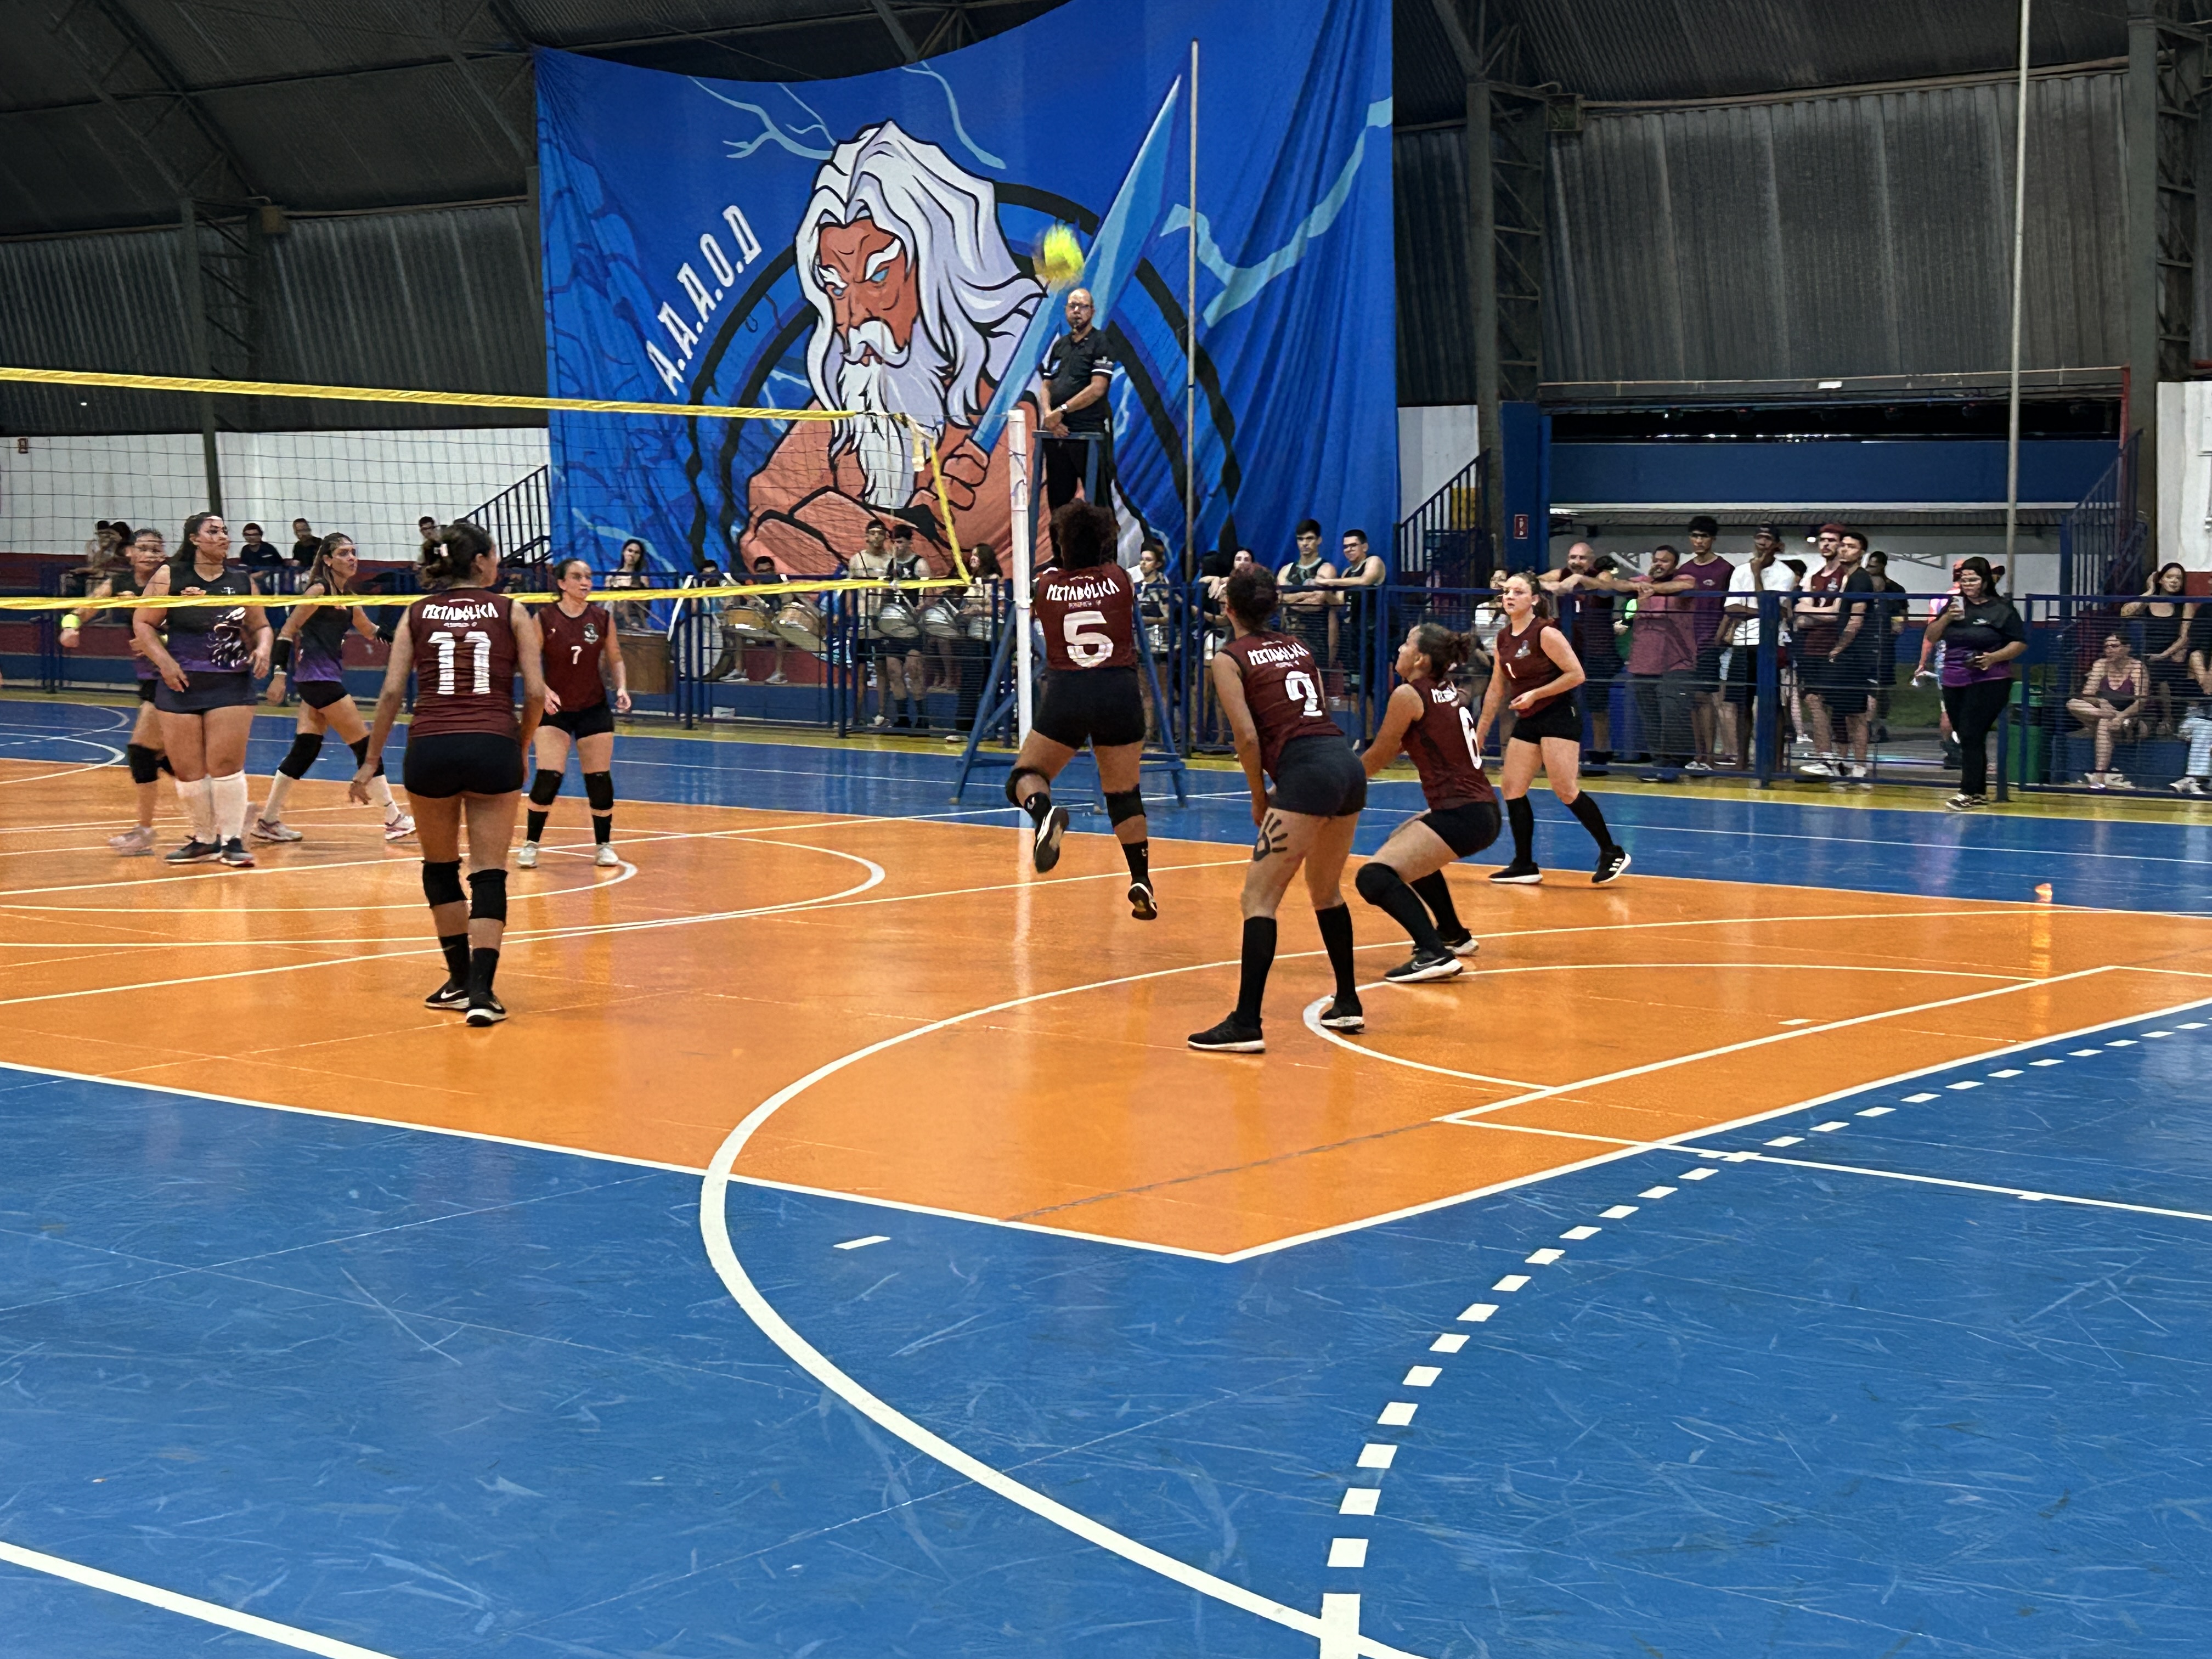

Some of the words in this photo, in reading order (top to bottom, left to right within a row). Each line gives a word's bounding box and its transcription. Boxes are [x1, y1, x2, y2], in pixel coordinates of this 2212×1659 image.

[427, 631, 491, 695] 11
[571, 646, 583, 664] 7
[1063, 611, 1114, 668] 5
[1285, 671, 1323, 716] 2
[1505, 663, 1516, 679] 1
[1459, 707, 1482, 769] 6
